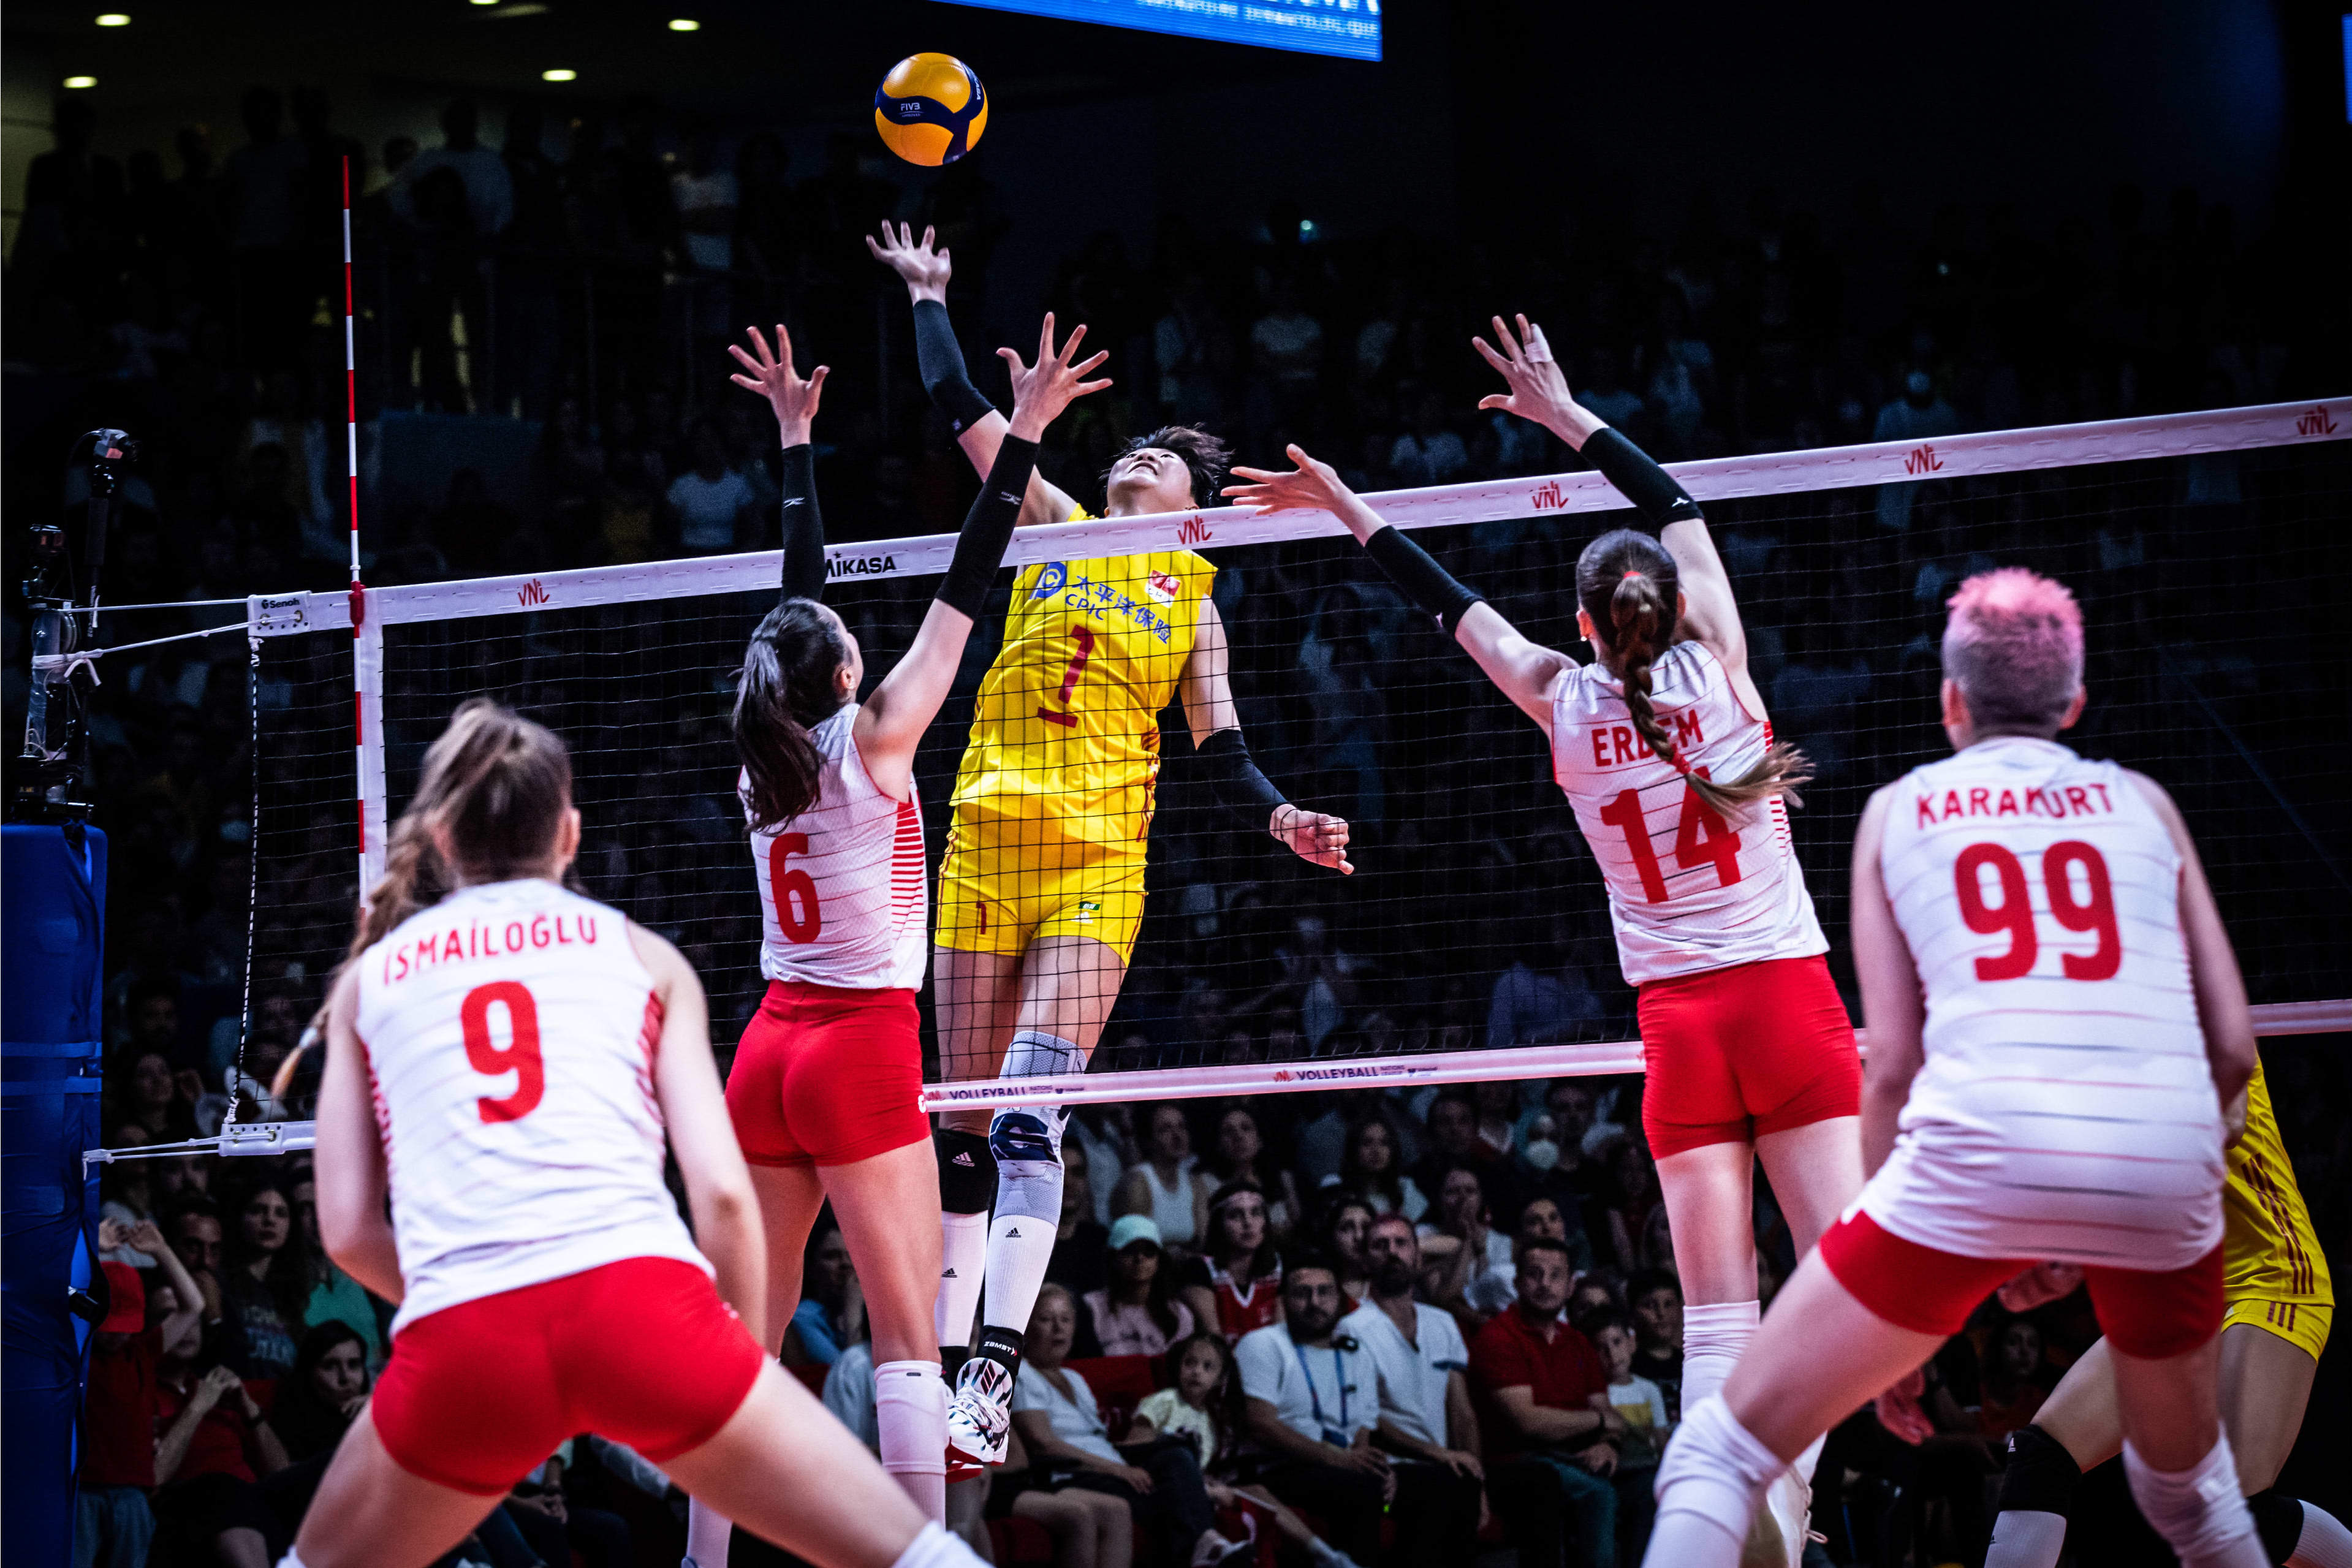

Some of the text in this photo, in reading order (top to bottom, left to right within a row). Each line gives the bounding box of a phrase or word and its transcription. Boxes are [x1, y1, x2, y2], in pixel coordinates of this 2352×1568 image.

[2297, 404, 2338, 436] VNL
[1904, 443, 1944, 475] VNL
[1531, 480, 1569, 509] VNL
[1177, 515, 1213, 545] VNL
[270, 598, 300, 608] Senoh
[517, 578, 550, 607] VNL
[1065, 593, 1107, 621] CPIC
[1071, 575, 1172, 645] 太平洋保险
[1037, 624, 1095, 728] 1
[1917, 782, 2113, 830] KARAKURT
[1599, 766, 1742, 904] 14
[770, 832, 821, 944] 6
[976, 901, 987, 935] 1
[1954, 840, 2122, 982] 99
[461, 980, 545, 1124] 9
[1296, 1067, 1378, 1081] VOLLEYBALL
[949, 1087, 1026, 1100] VOLLEYBALL
